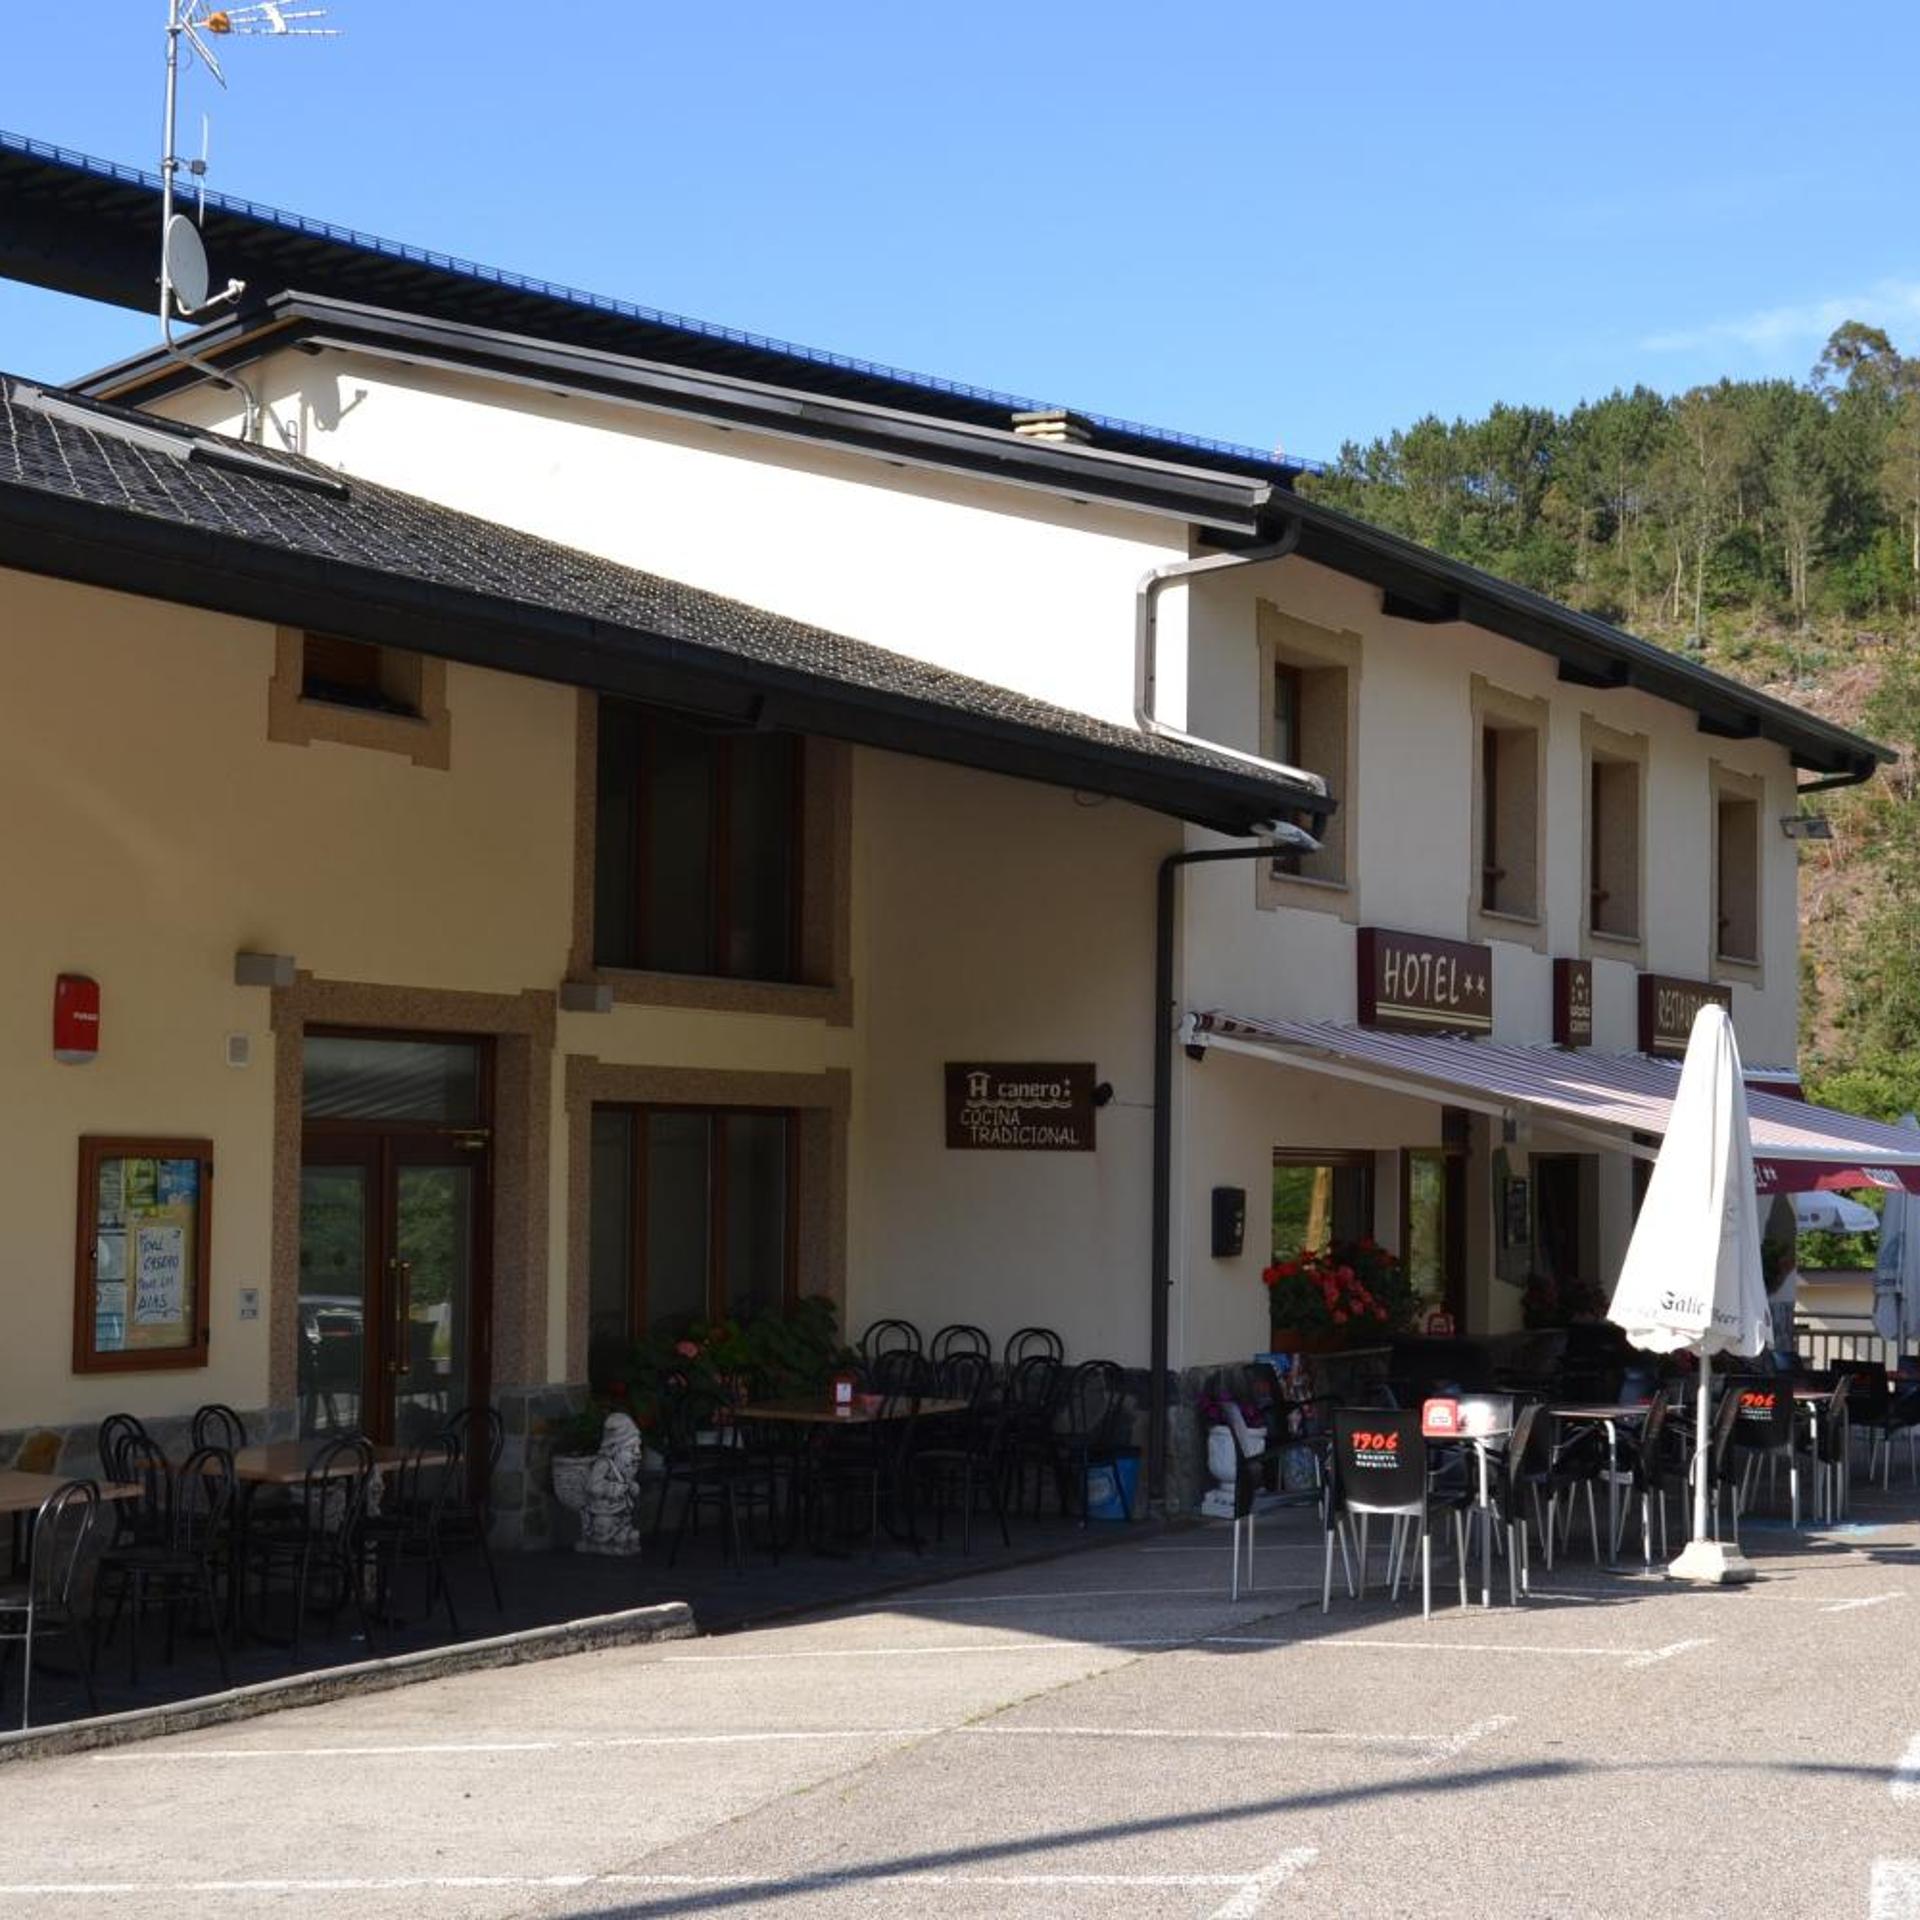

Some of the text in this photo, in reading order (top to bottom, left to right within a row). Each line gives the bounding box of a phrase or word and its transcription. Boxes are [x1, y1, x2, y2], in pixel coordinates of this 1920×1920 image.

[1385, 948, 1459, 1005] HOTEL
[998, 1081, 1061, 1097] canero
[960, 1108, 1021, 1125] COCINA
[970, 1126, 1080, 1144] TRADICIONAL
[1351, 1431, 1398, 1449] 1906
